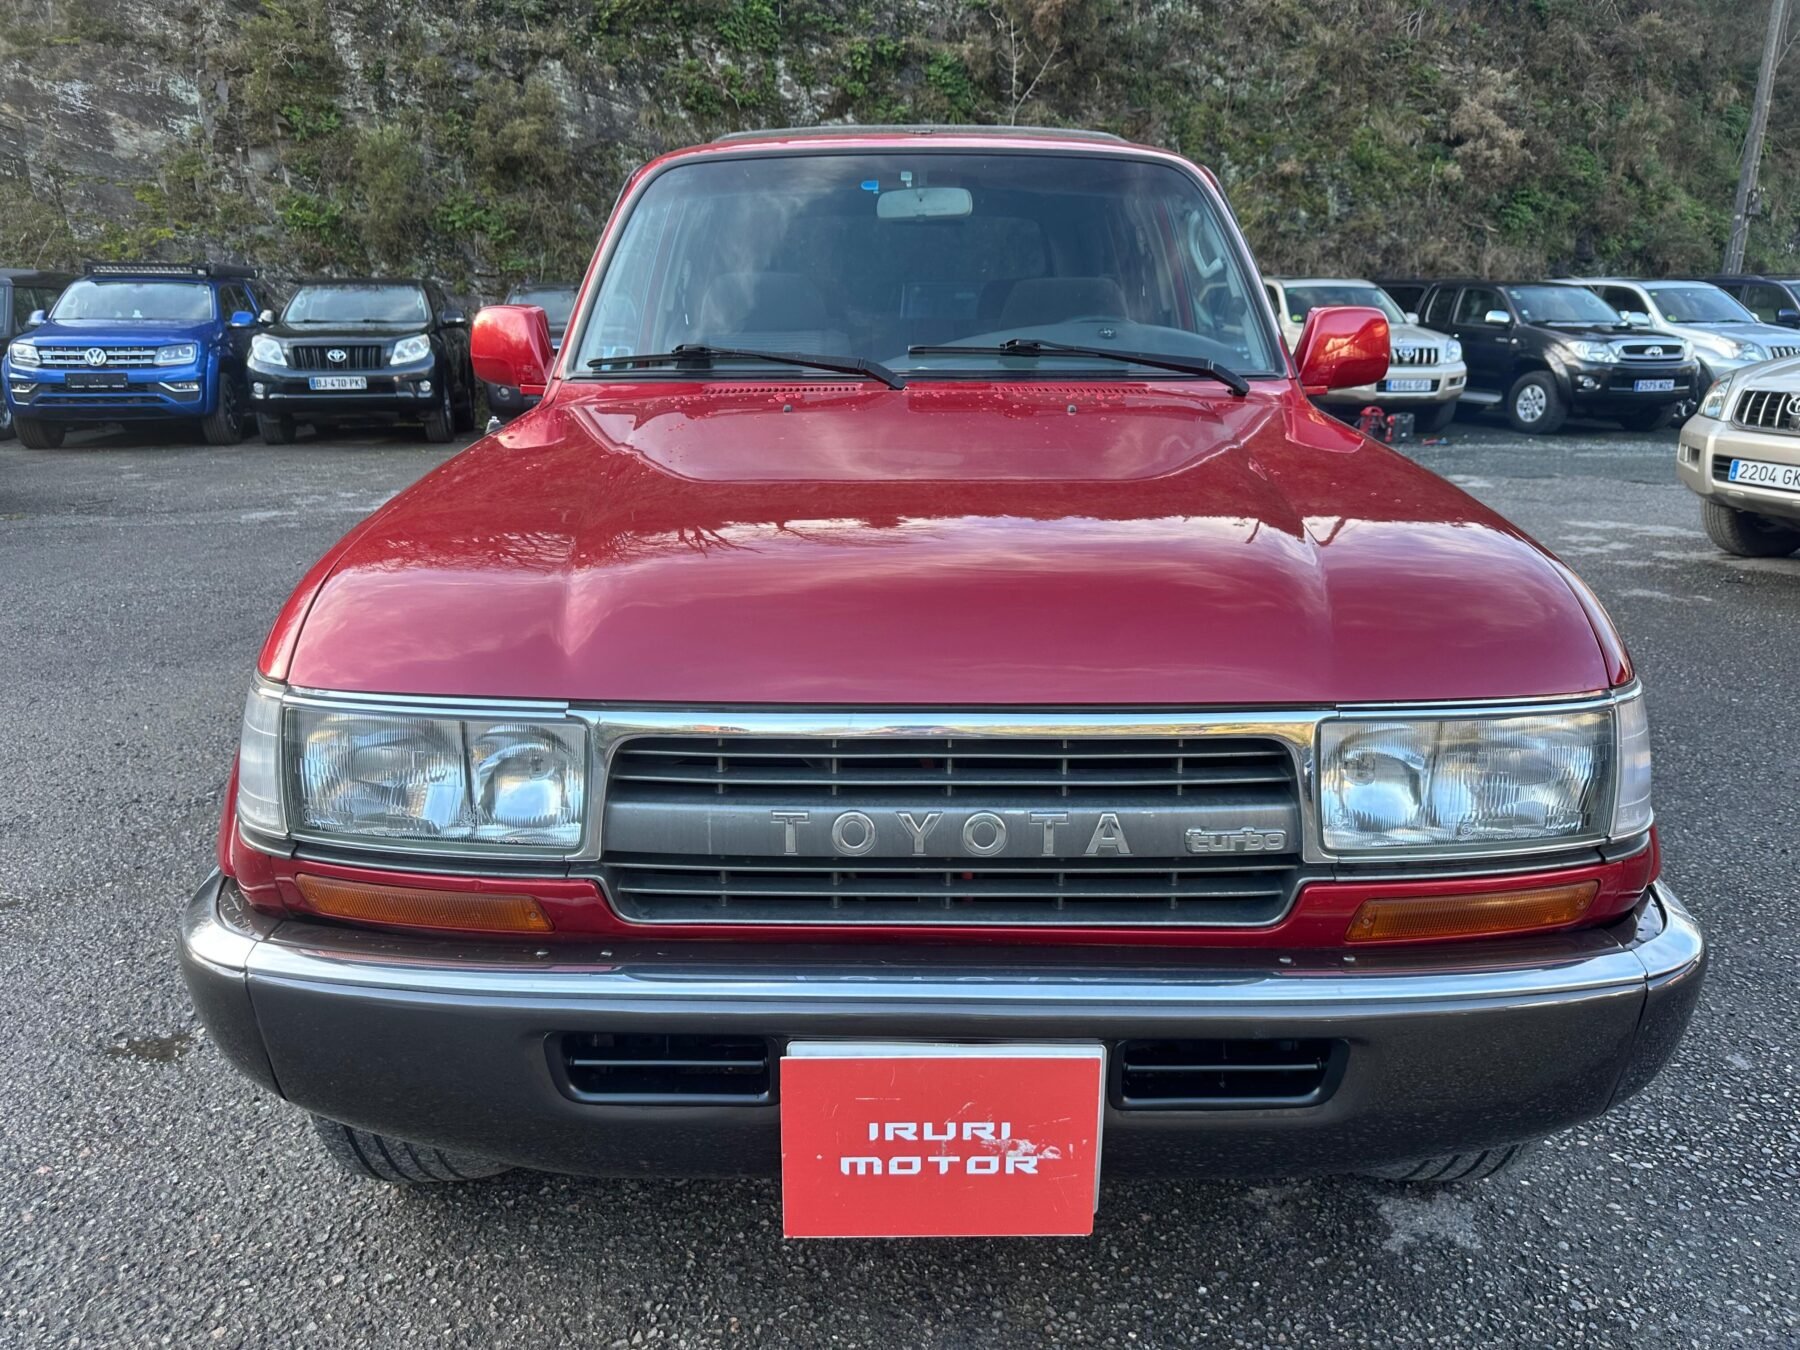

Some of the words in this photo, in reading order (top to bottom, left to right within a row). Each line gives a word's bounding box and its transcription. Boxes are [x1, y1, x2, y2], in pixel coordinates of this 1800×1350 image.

[1739, 463, 1776, 483] 2204
[1783, 469, 1800, 487] GK
[771, 811, 1133, 856] TOYOTA
[1188, 829, 1285, 852] turbo
[868, 1122, 1011, 1141] IRURI
[840, 1156, 1038, 1175] MOTOR
